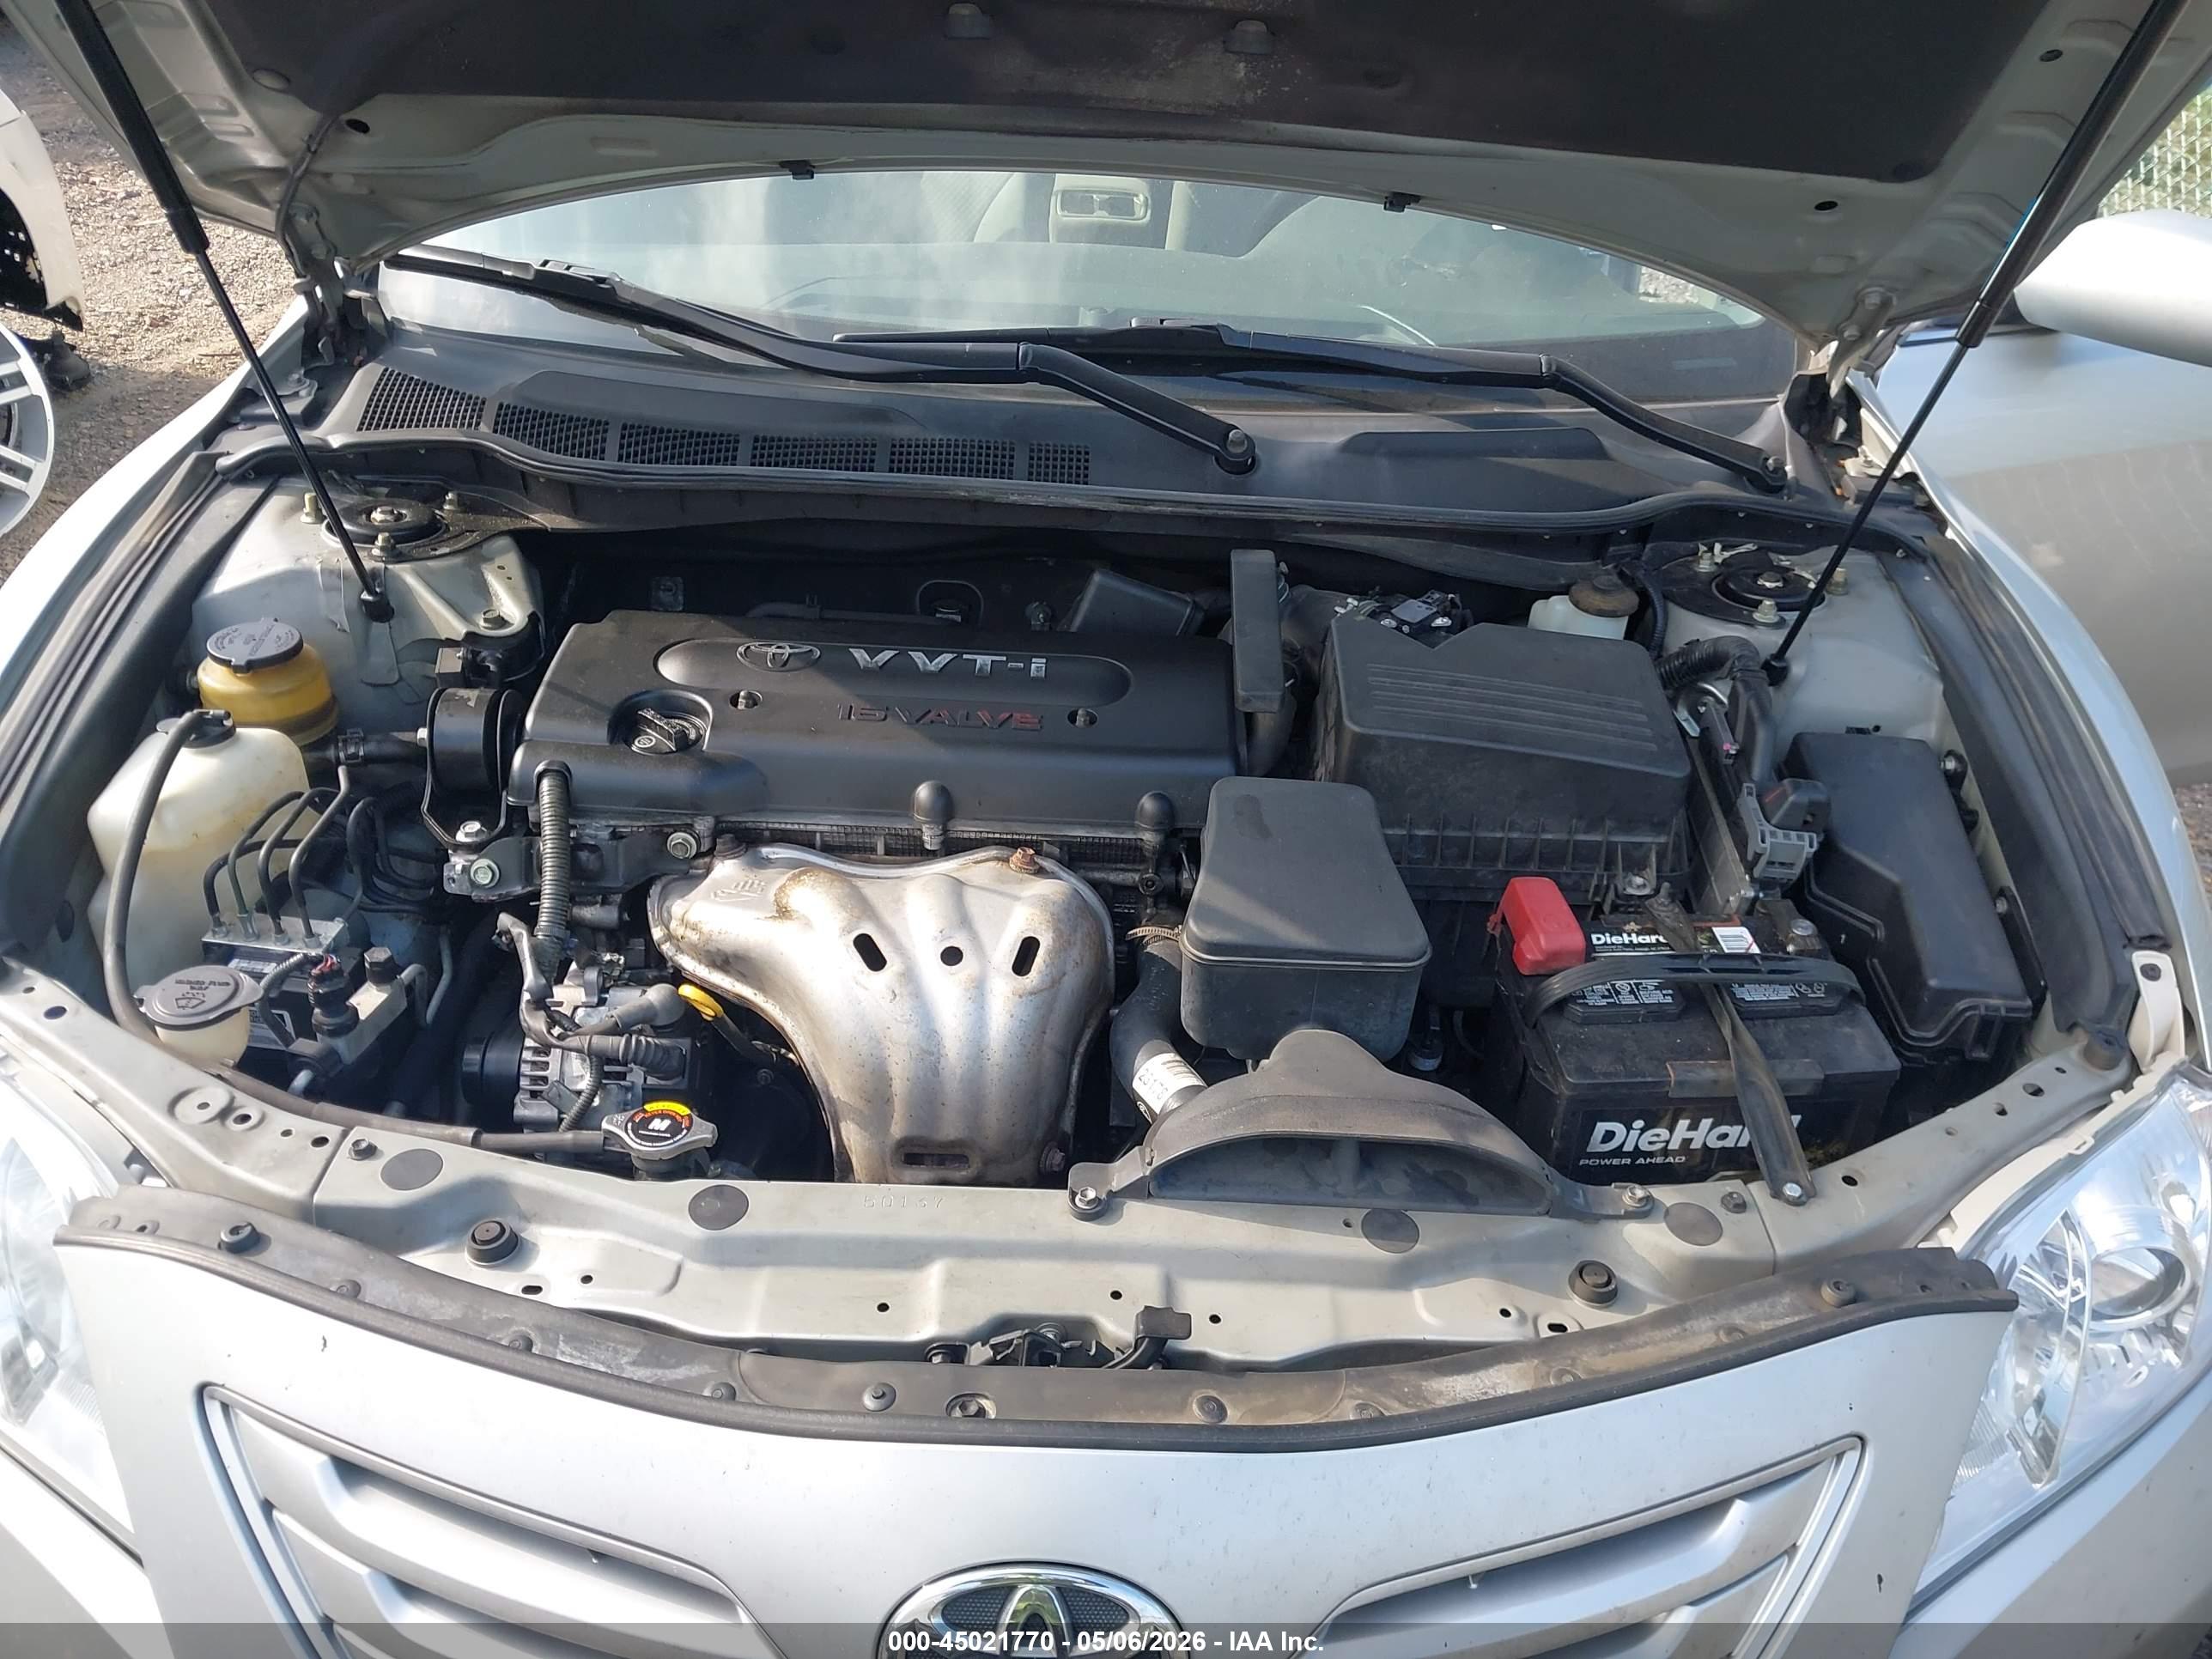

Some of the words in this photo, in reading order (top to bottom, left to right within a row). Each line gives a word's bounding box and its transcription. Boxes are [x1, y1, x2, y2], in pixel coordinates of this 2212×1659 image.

[848, 647, 1047, 678] VVT-i
[895, 707, 1044, 732] VALVE
[1579, 1157, 1632, 1167] POWER
[1634, 1155, 1686, 1165] AHEAD
